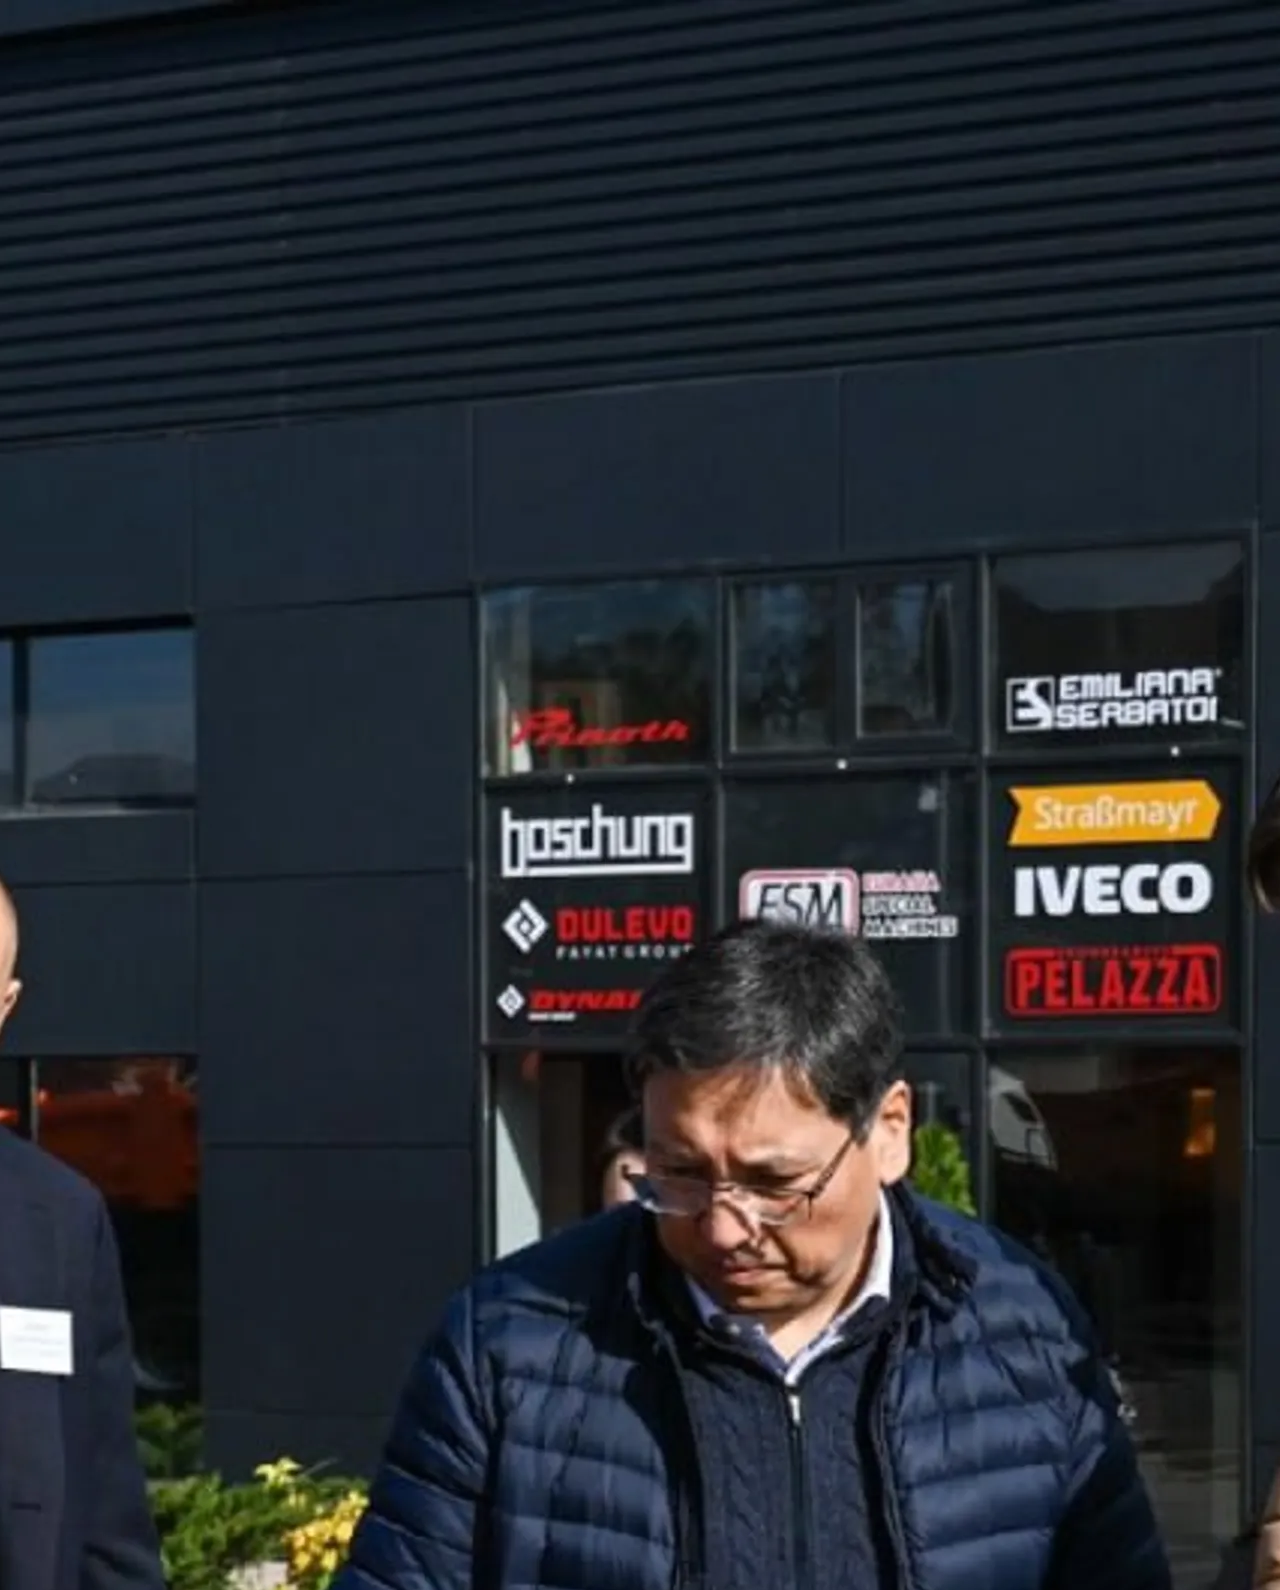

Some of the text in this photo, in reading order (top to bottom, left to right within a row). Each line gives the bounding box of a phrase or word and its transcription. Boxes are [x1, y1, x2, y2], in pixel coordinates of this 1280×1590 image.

[1059, 668, 1214, 700] EMILIANA
[1055, 696, 1218, 730] SERBATOI
[1033, 793, 1198, 834] Straßmayr
[501, 803, 694, 878] boschung
[1014, 861, 1213, 917] IVECO
[556, 906, 694, 942] DULEVO
[1016, 957, 1210, 1009] PELAZZA
